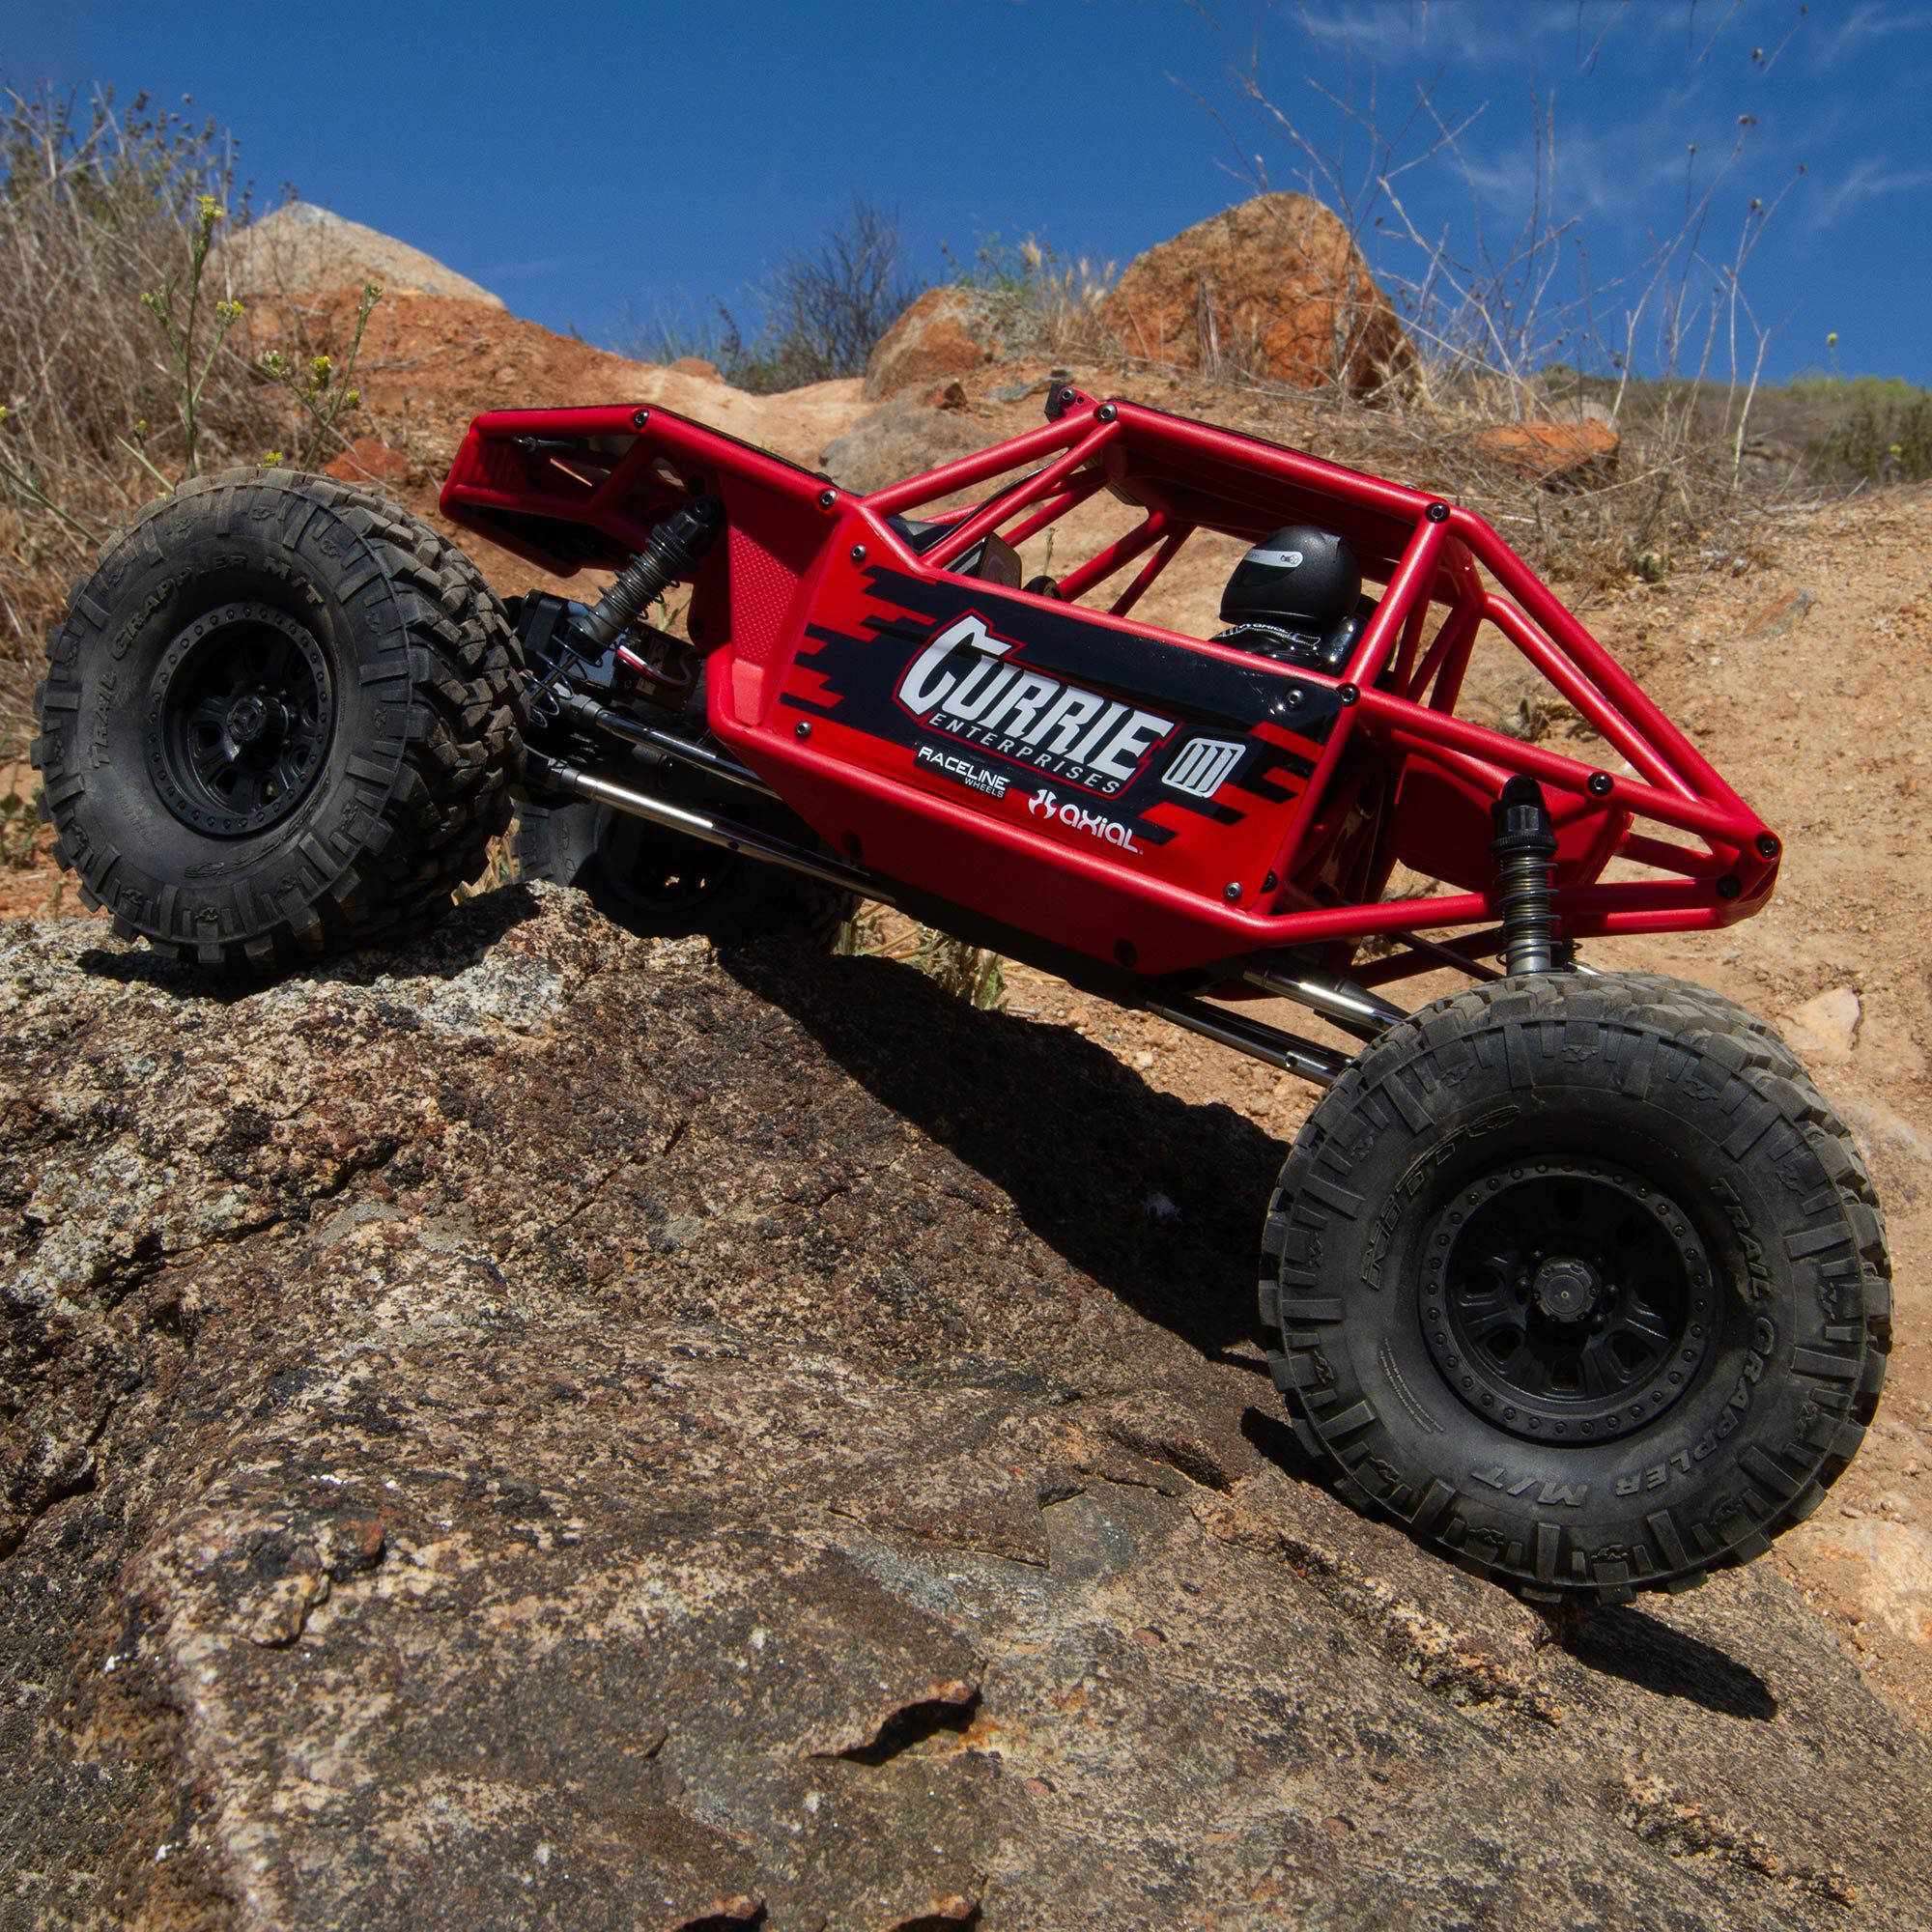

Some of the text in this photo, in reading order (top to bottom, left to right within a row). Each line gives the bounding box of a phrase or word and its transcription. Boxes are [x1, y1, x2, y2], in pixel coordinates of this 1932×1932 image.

[898, 614, 1176, 781] CURRIE
[918, 746, 1011, 791] RACELINE
[928, 712, 1121, 795] ENTERPRISES
[964, 777, 1005, 799] WHEELS
[1469, 1177, 1776, 1508] TRAIL GRAPPLER M/T
